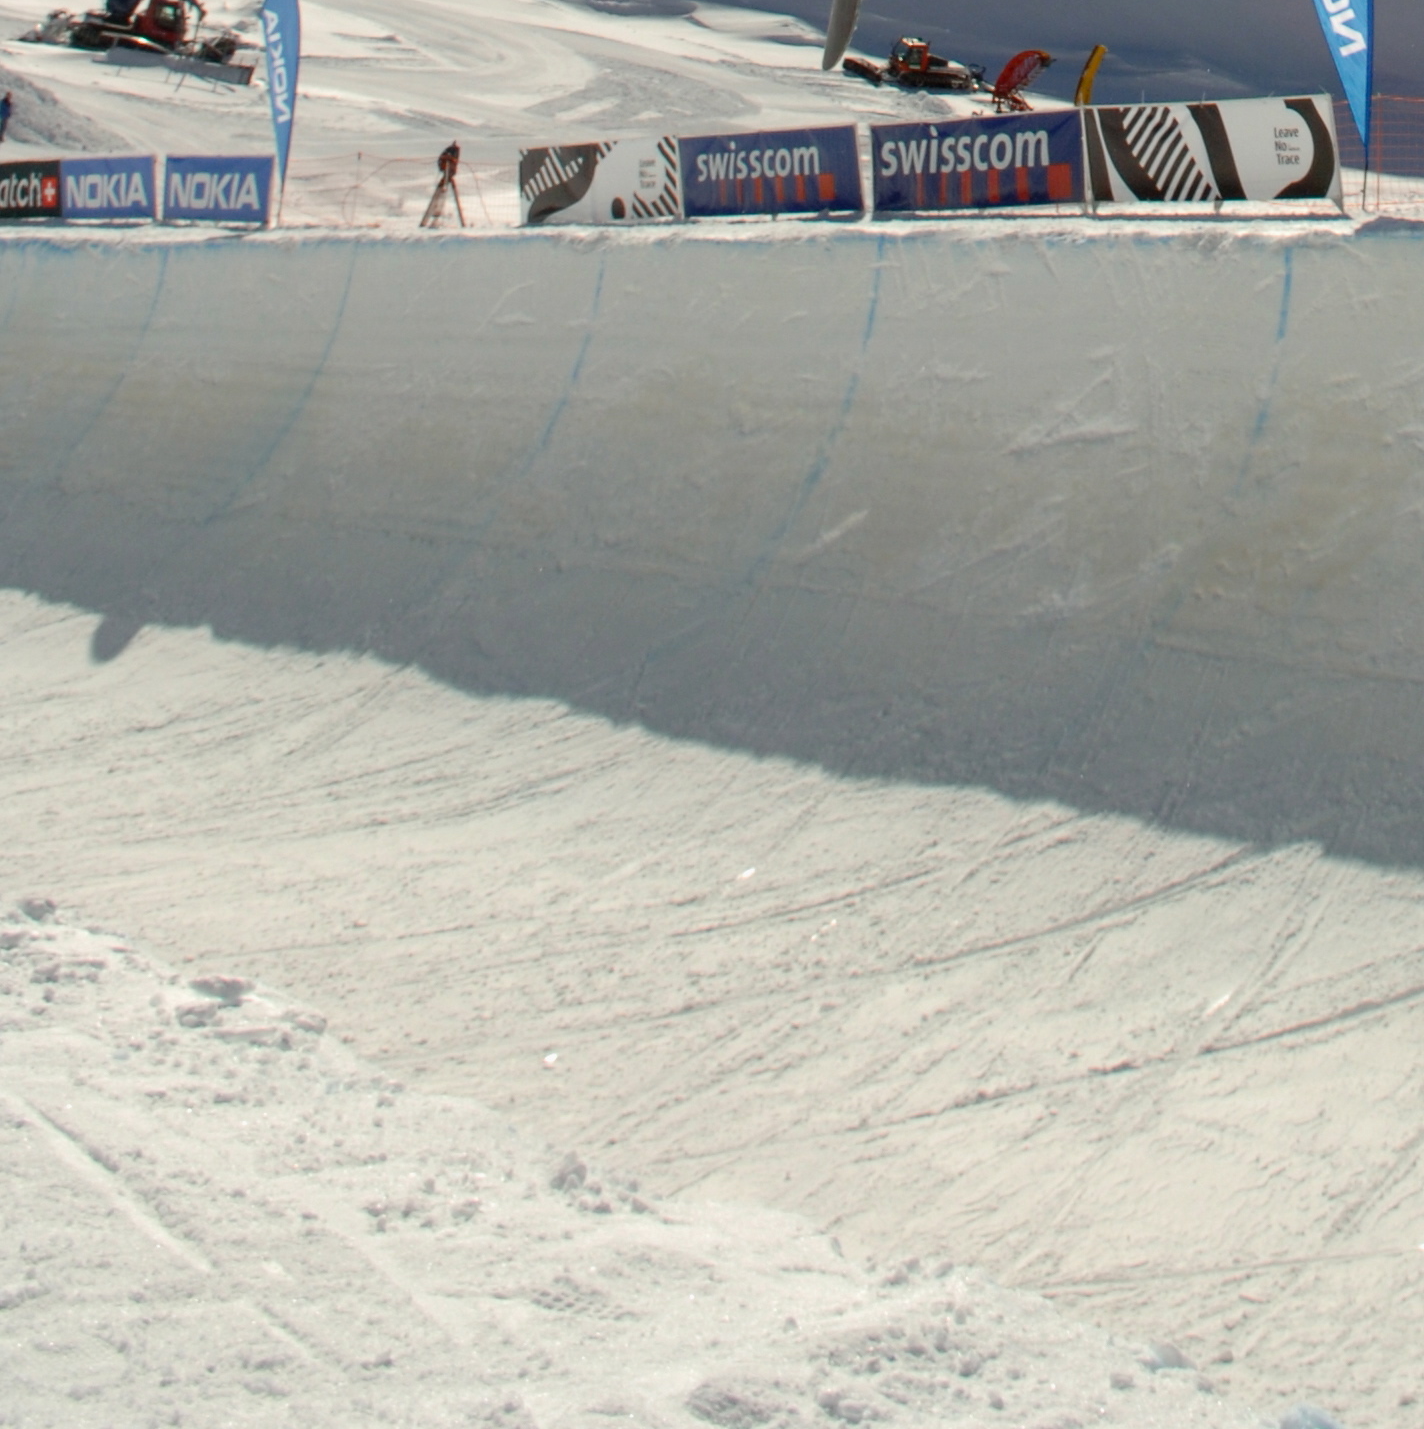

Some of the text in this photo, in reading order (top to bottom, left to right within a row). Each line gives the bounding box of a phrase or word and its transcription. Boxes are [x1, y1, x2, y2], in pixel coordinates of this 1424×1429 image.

[1273, 127, 1299, 139] Leave
[696, 139, 821, 183] swisscom
[880, 126, 1050, 178] swisscom
[1276, 153, 1300, 165] Trace
[66, 172, 147, 208] NOKIA
[169, 173, 260, 210] NOKIA
